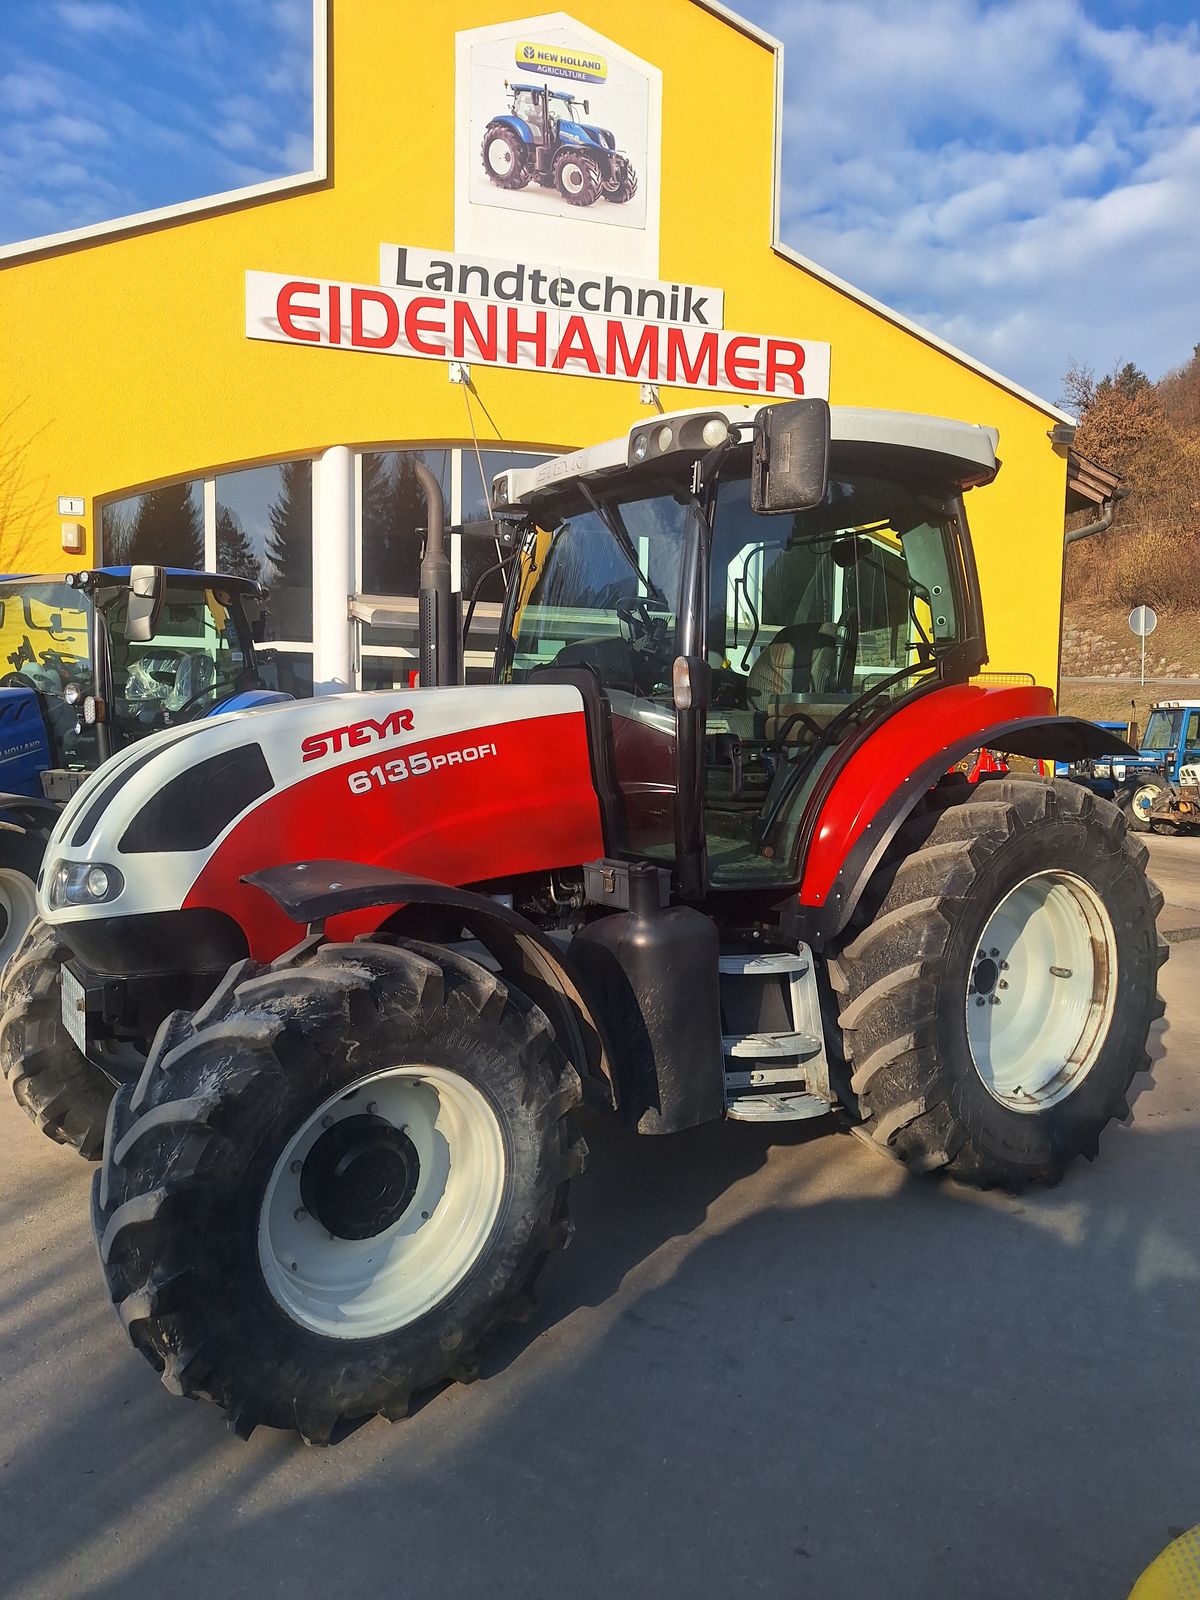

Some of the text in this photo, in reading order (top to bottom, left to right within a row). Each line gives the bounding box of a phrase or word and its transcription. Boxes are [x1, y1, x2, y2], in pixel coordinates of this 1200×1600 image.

[537, 51, 601, 70] NEW HOLLAND
[537, 65, 587, 79] AGRICULTURE
[396, 247, 709, 325] Landtechnik
[276, 281, 806, 396] EIDENHAMMER
[301, 708, 415, 763] STEYR
